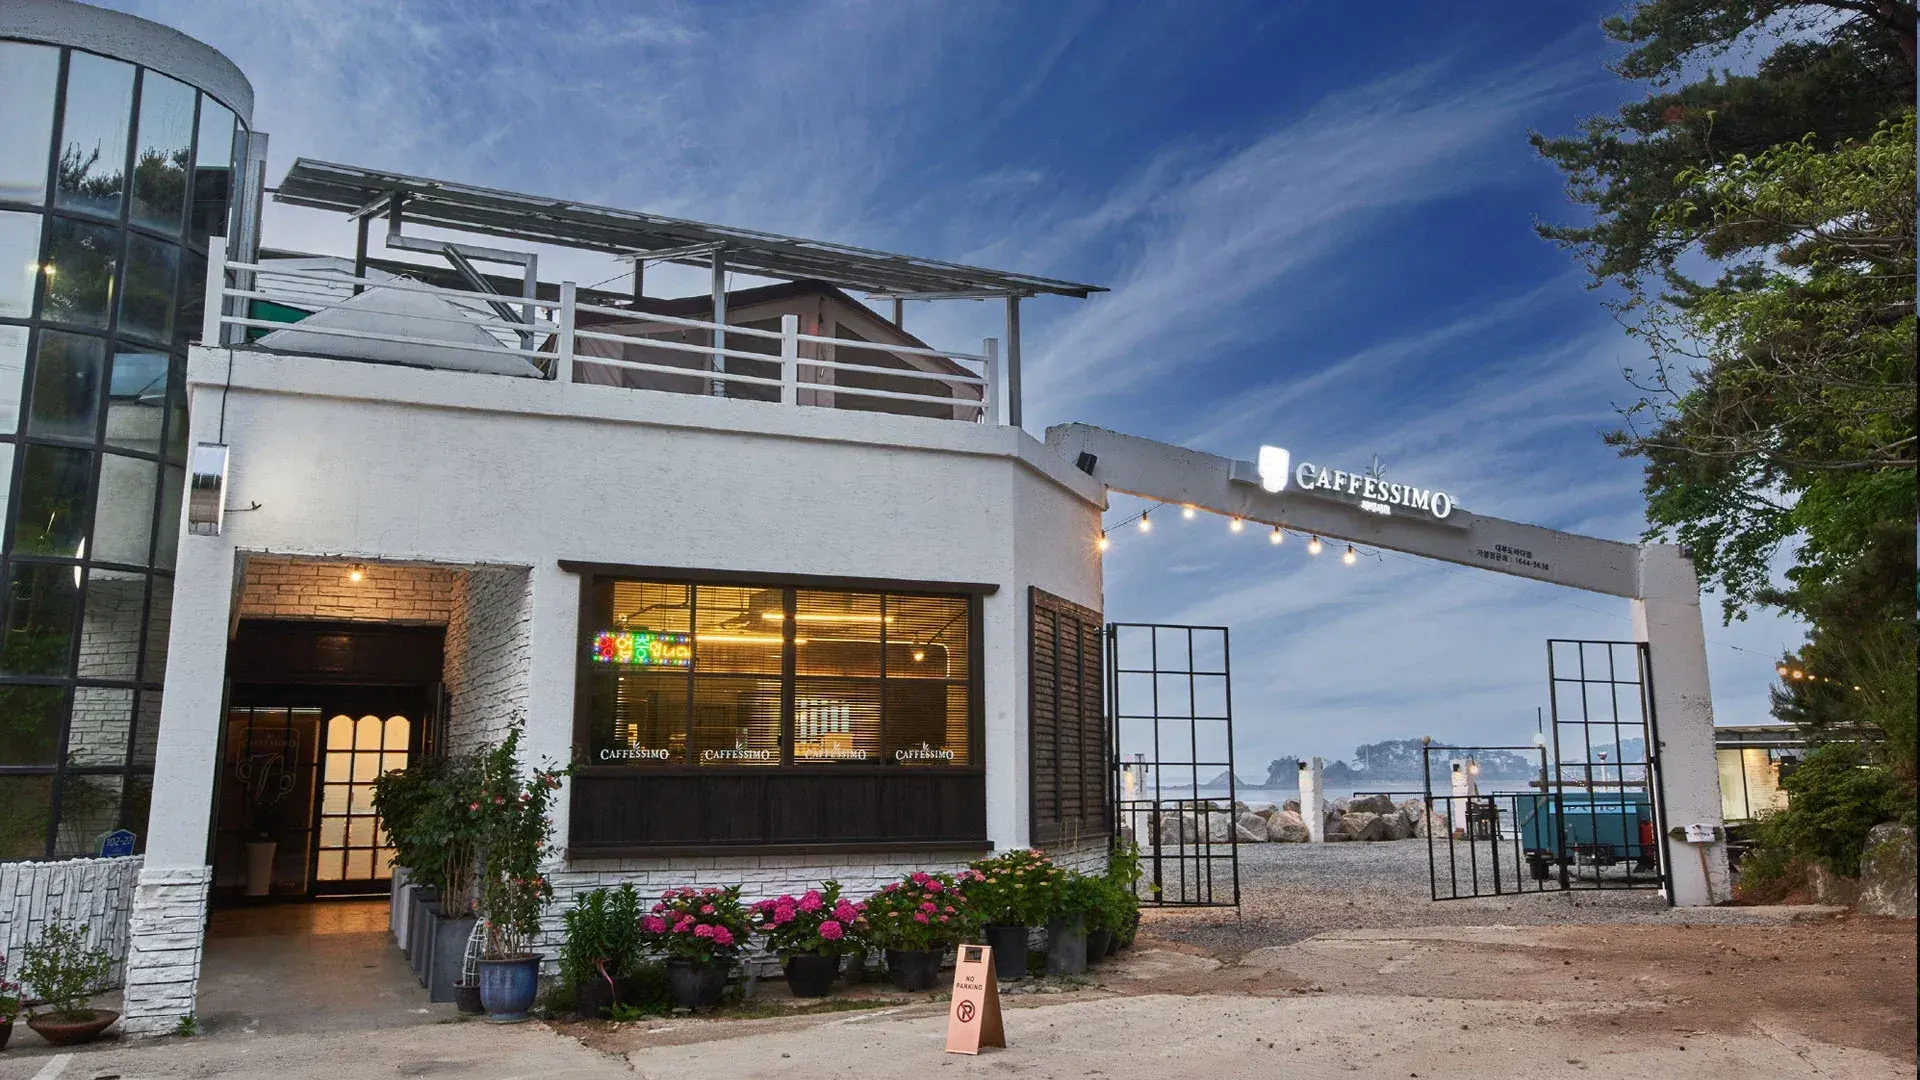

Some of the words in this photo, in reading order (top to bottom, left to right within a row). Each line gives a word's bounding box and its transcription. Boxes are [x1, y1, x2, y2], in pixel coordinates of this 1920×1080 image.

[1296, 462, 1451, 518] CAFFESSIMO
[599, 636, 691, 659] 영업중입니다
[600, 749, 669, 760] CAFFESSIMO
[705, 749, 770, 760] CAFFESSIMO
[805, 749, 867, 760] CAFFESSIMO
[895, 749, 954, 760] CAFFESSIMO
